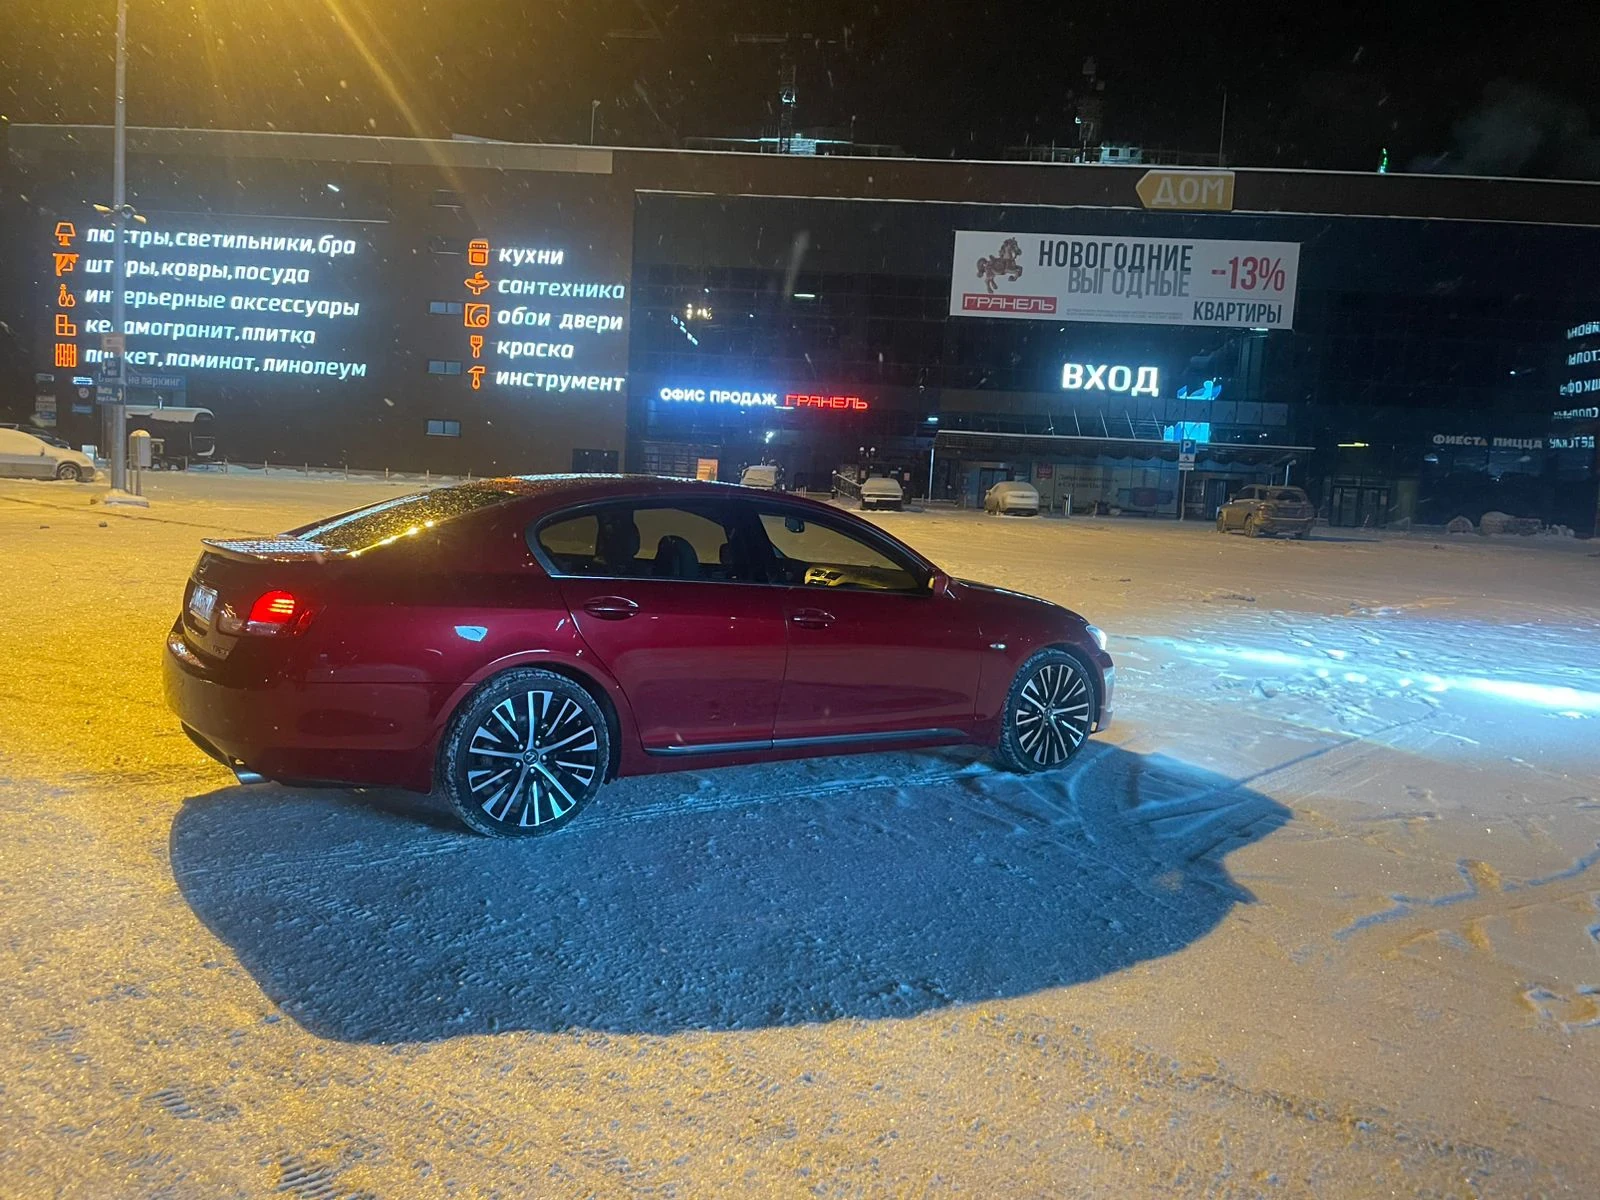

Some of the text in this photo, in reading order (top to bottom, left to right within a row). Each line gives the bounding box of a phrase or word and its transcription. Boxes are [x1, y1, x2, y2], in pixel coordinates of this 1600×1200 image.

[1152, 177, 1225, 206] ДОМ
[498, 247, 565, 267] кухни
[1039, 240, 1194, 273] НОВОГОДНИЕ
[1067, 268, 1191, 300] ВЫГОДНЫЕ
[1211, 256, 1286, 292] -13%
[498, 278, 626, 299] сантехника
[85, 289, 360, 319] инерьерные аксессуары
[1193, 301, 1282, 325] КВАРТИРЫ
[497, 306, 623, 334] обои двери
[497, 341, 574, 360] краска
[263, 357, 367, 380] линолеум
[1062, 364, 1159, 397] ВХОД
[496, 370, 626, 393] инструмент
[660, 387, 706, 402] ОФИС
[710, 390, 778, 406] ПРОДАЖ
[1493, 437, 1543, 449] ПИЦЦА
